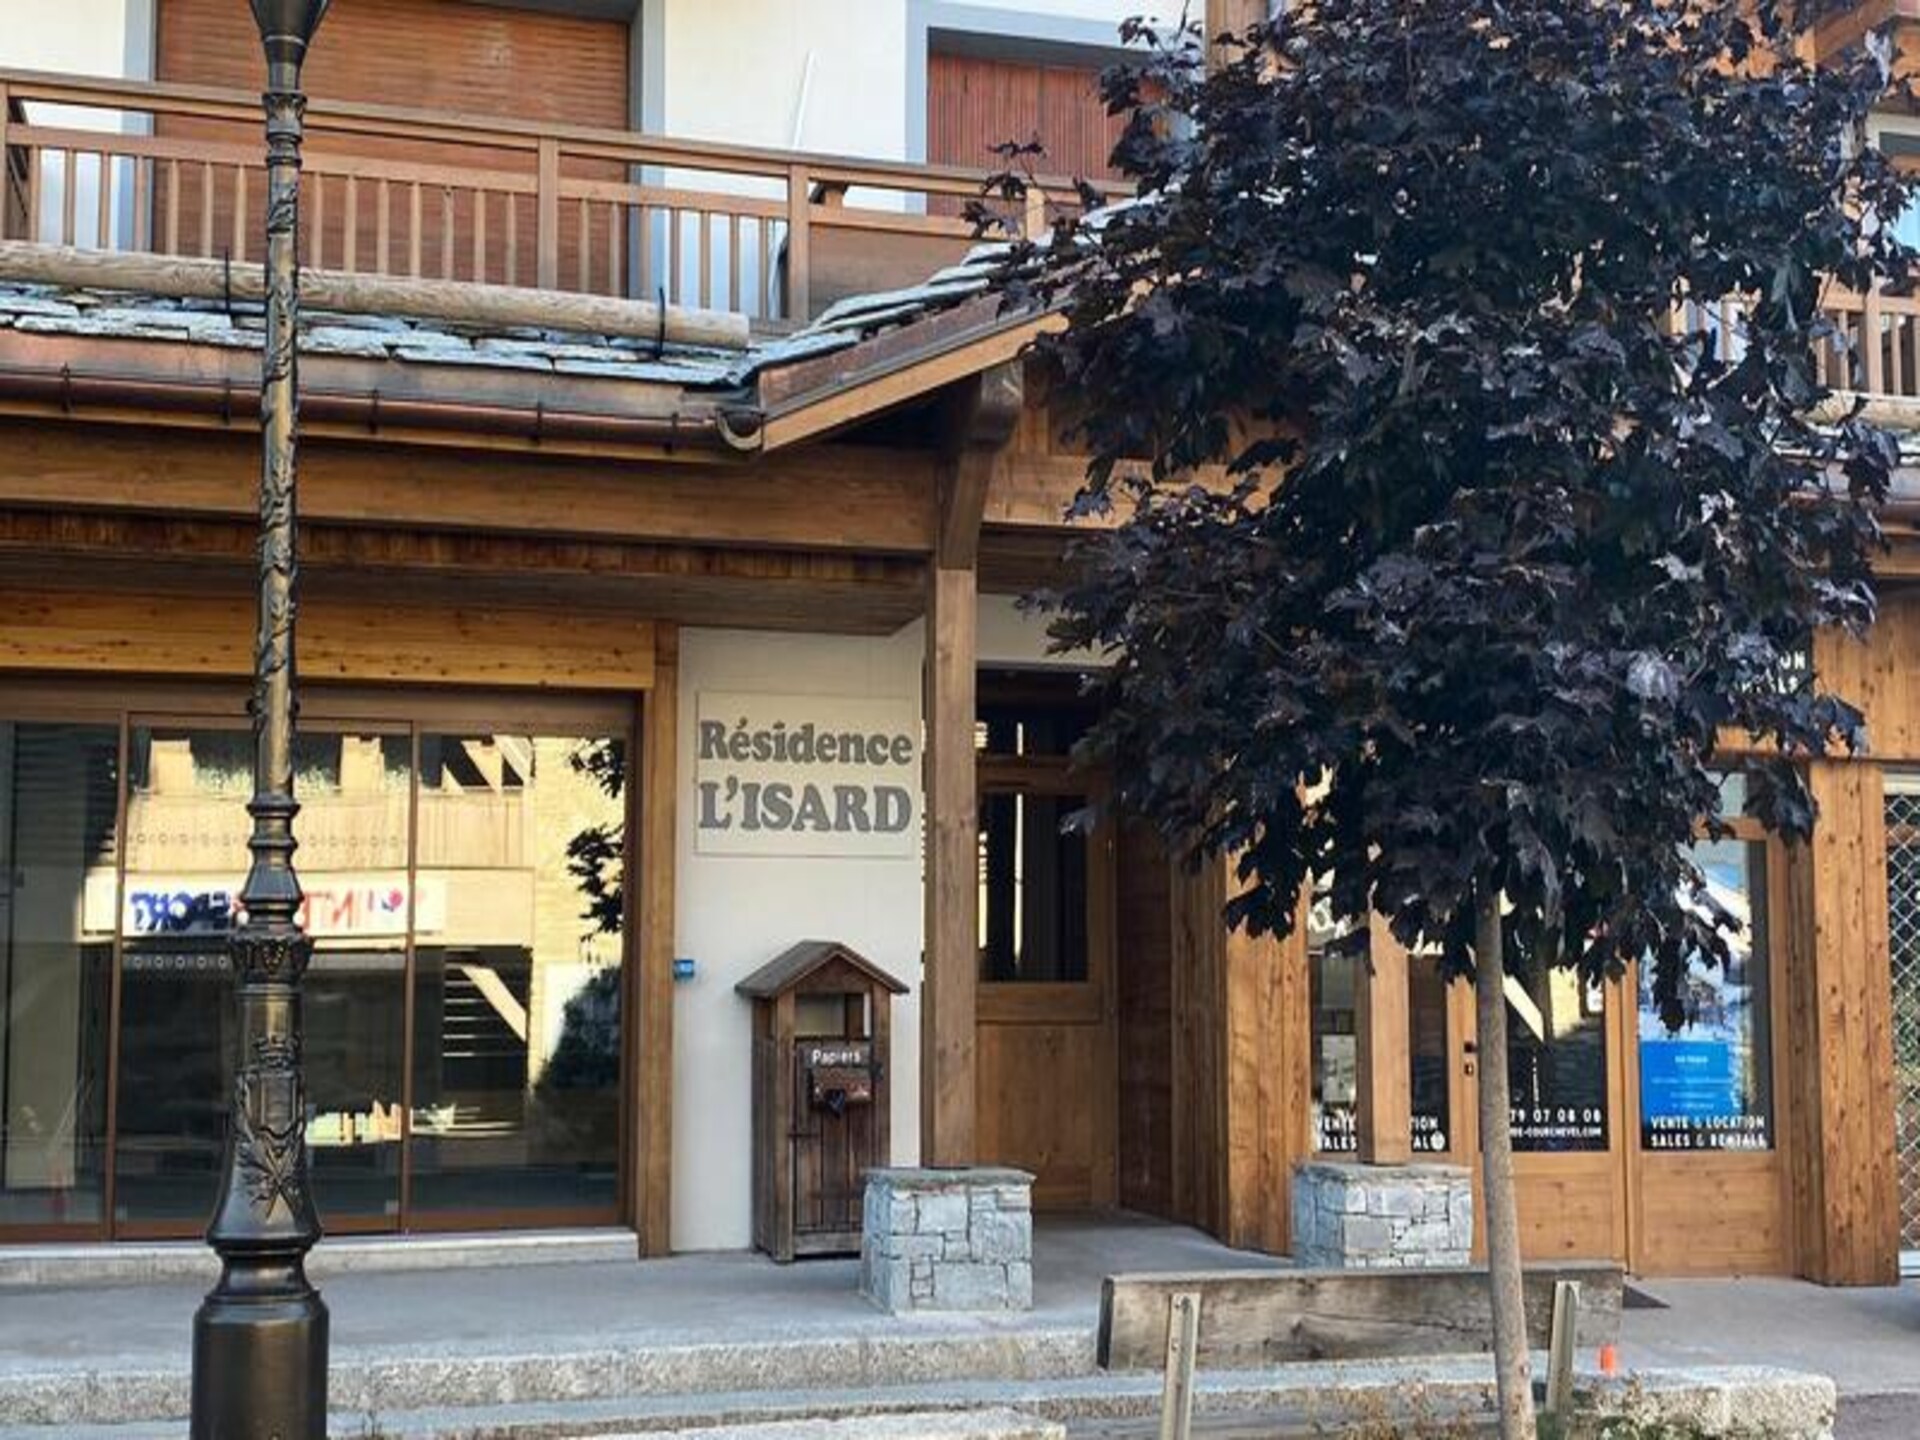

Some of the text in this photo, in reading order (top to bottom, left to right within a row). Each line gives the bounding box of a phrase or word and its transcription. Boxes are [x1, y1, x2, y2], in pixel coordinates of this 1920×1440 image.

[699, 716, 913, 765] Résidence
[699, 775, 913, 832] L'ISARD
[1533, 1108, 1550, 1122] 07
[1651, 1115, 1688, 1129] VENTE
[1706, 1115, 1765, 1129] LOCATION
[1651, 1134, 1690, 1147] SALES
